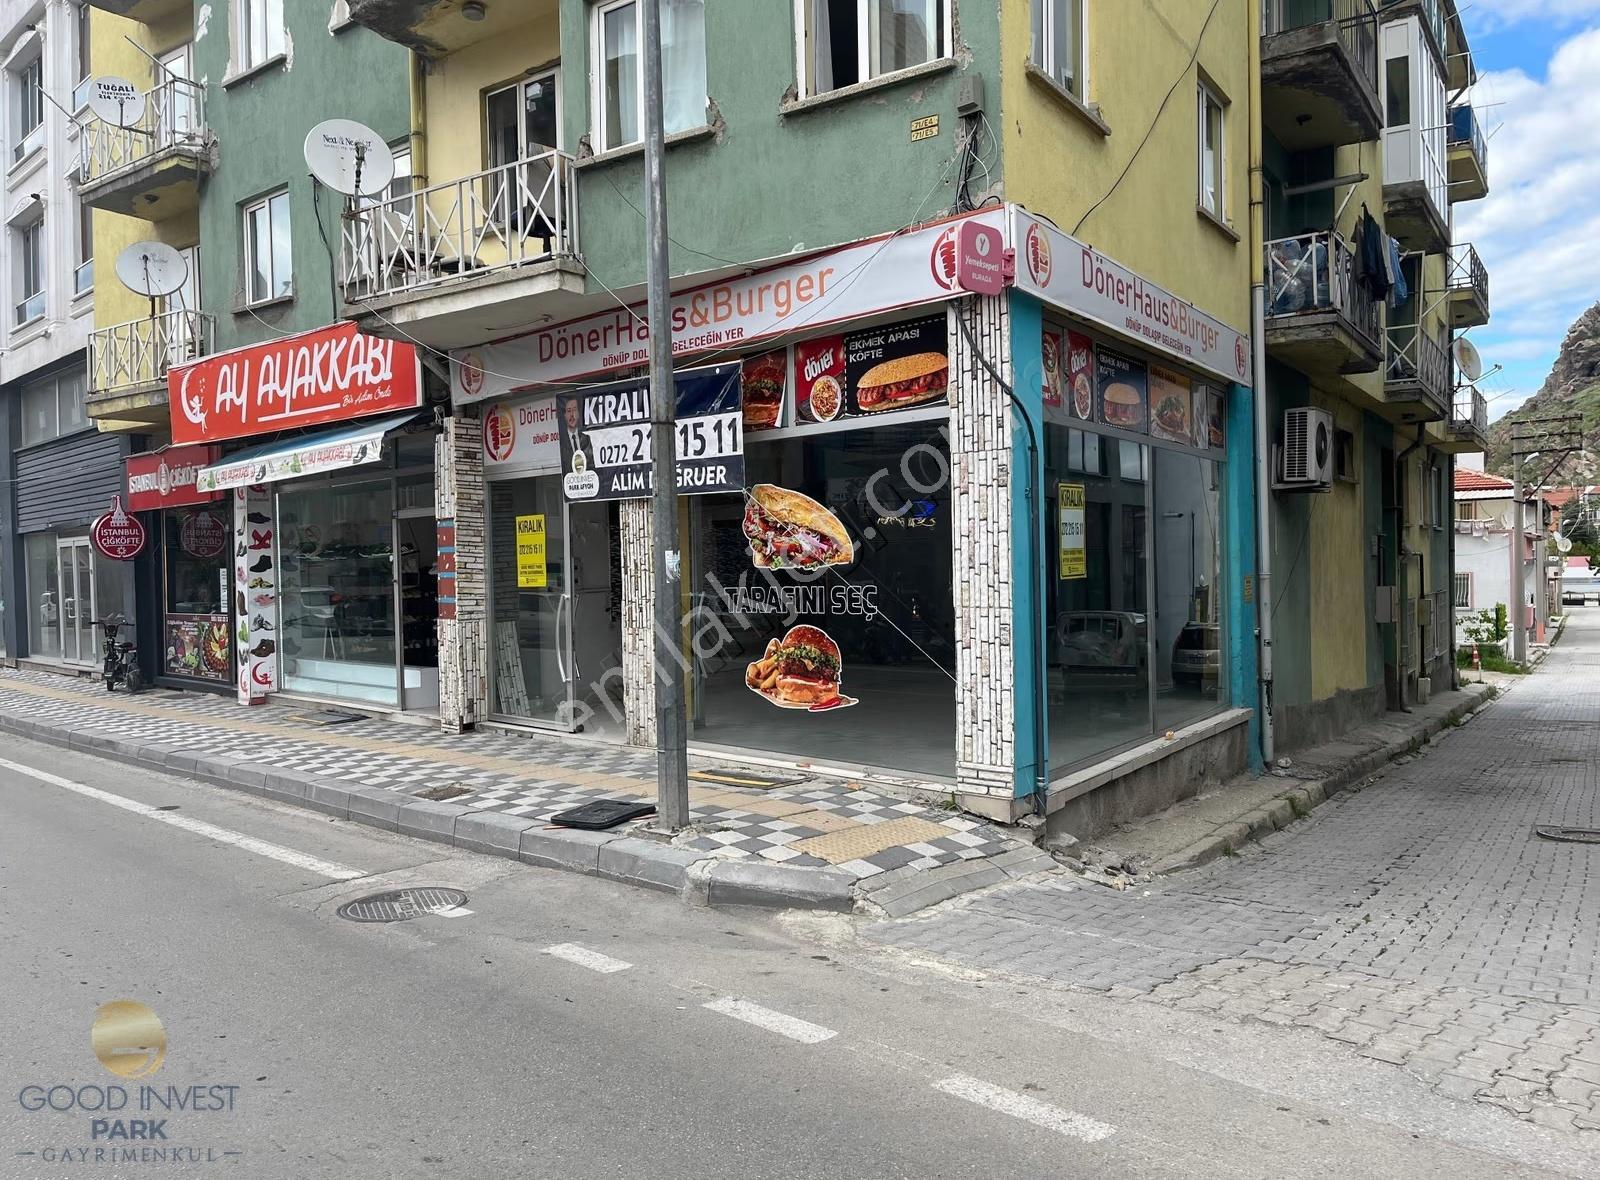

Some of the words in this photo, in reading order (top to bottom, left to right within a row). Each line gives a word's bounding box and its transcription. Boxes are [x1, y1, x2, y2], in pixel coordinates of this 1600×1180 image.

[538, 267, 835, 364] DönerHas&Burger
[724, 326, 745, 347] YER
[850, 335, 885, 351] EKMEK
[887, 328, 920, 344] ARASI
[602, 350, 630, 368] DÖNÜP
[849, 347, 883, 363] KÖFTE
[215, 358, 249, 424] AY
[600, 444, 628, 465] 0272
[679, 421, 706, 457] 15
[712, 416, 738, 454] 11
[610, 466, 646, 492] ALİM
[101, 528, 140, 536] İSTANBUL
[101, 536, 141, 548] ÇİĞKÖFTE
[724, 585, 826, 615] TARAFINI
[830, 585, 879, 622] SEÇ
